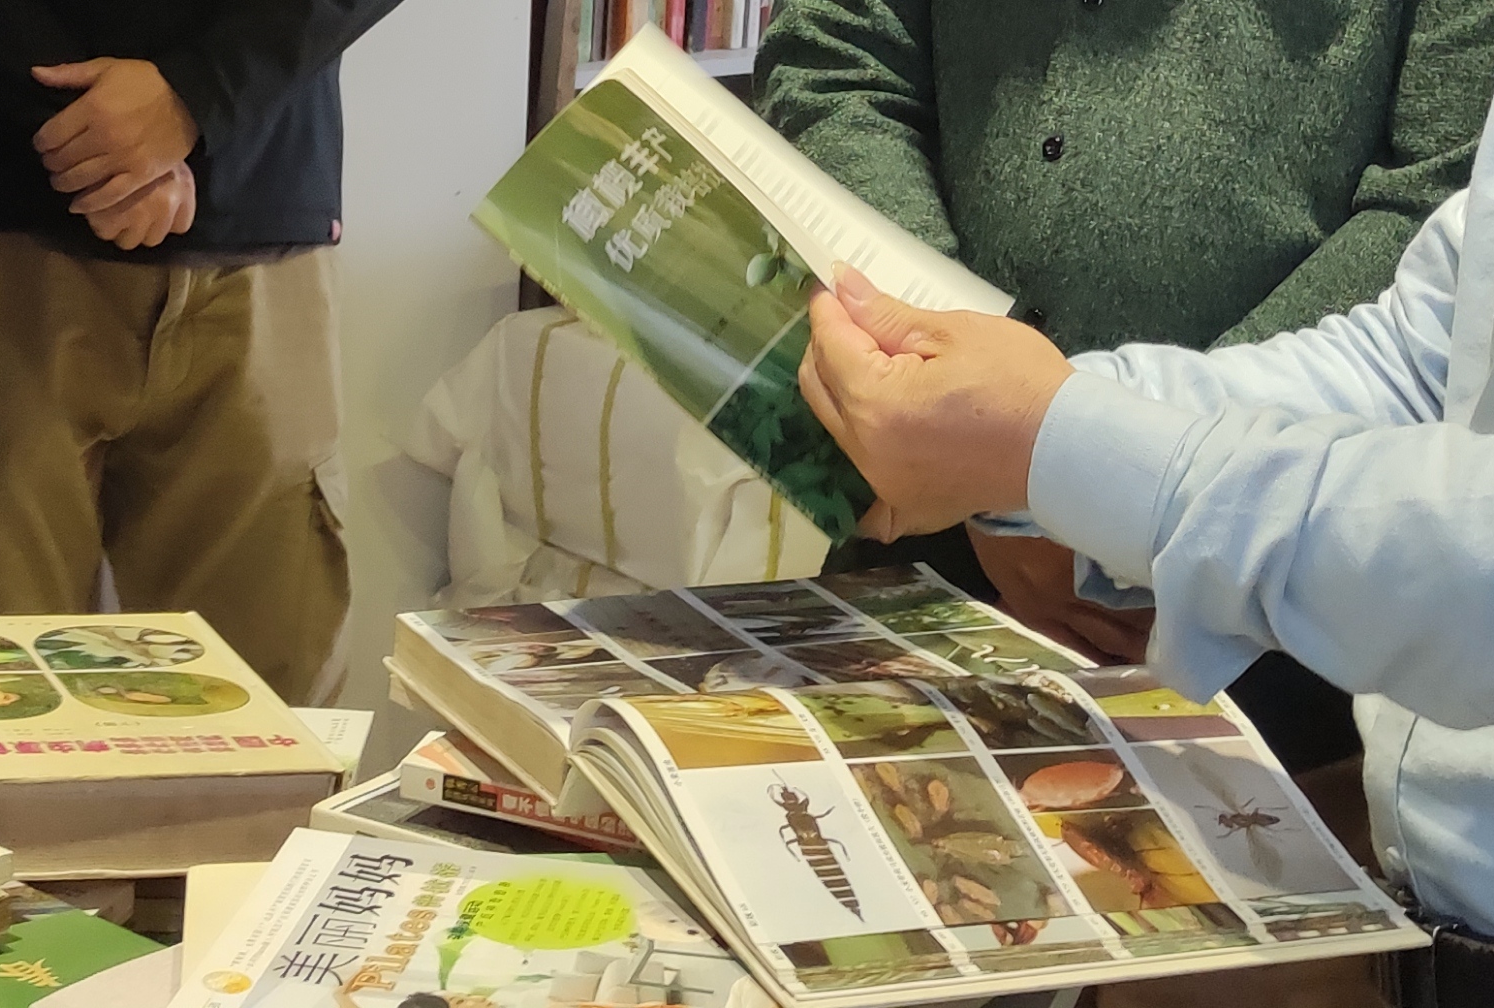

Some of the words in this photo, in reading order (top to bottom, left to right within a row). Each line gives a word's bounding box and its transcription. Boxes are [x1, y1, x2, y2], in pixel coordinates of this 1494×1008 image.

[272, 853, 414, 987] 美丽妈妈
[347, 908, 438, 992] Pilates
